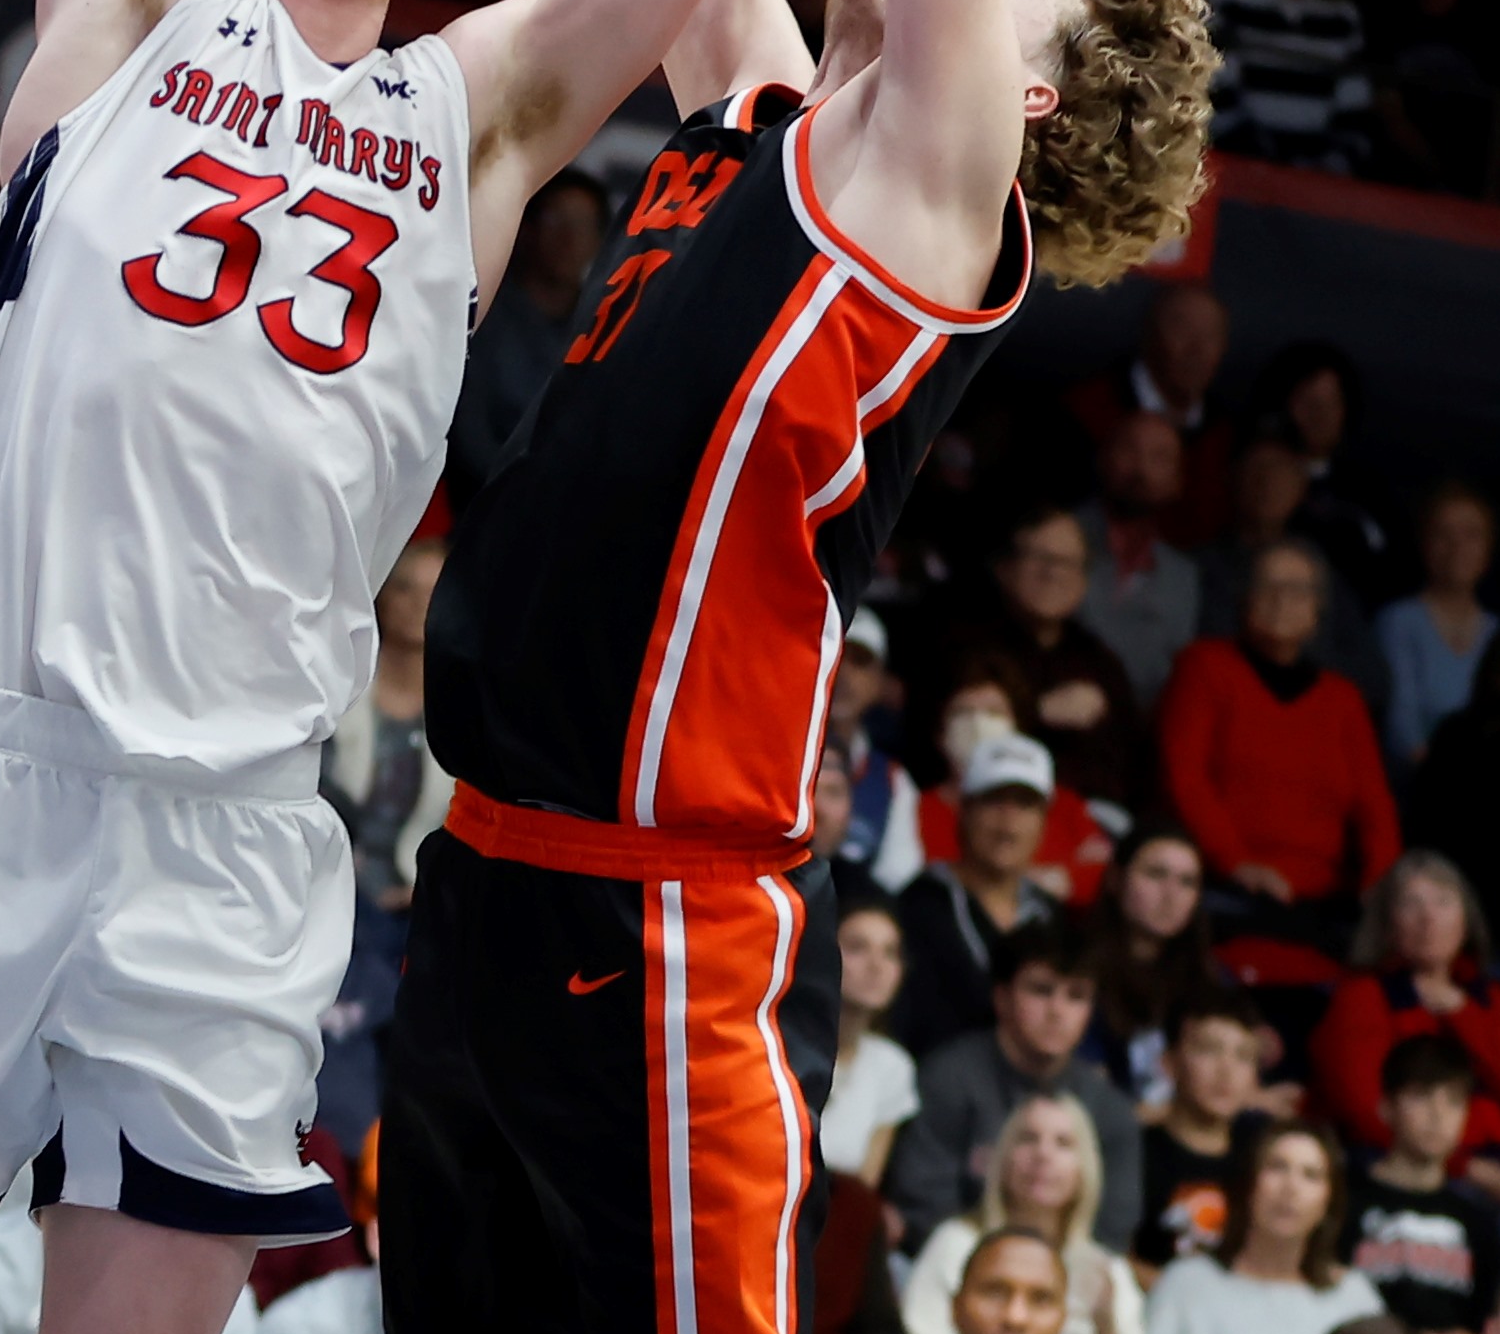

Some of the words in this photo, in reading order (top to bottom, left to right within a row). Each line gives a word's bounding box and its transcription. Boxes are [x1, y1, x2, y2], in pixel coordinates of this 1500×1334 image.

[149, 60, 284, 149] SAINT
[296, 97, 442, 212] MARY'S
[121, 151, 400, 375] 33
